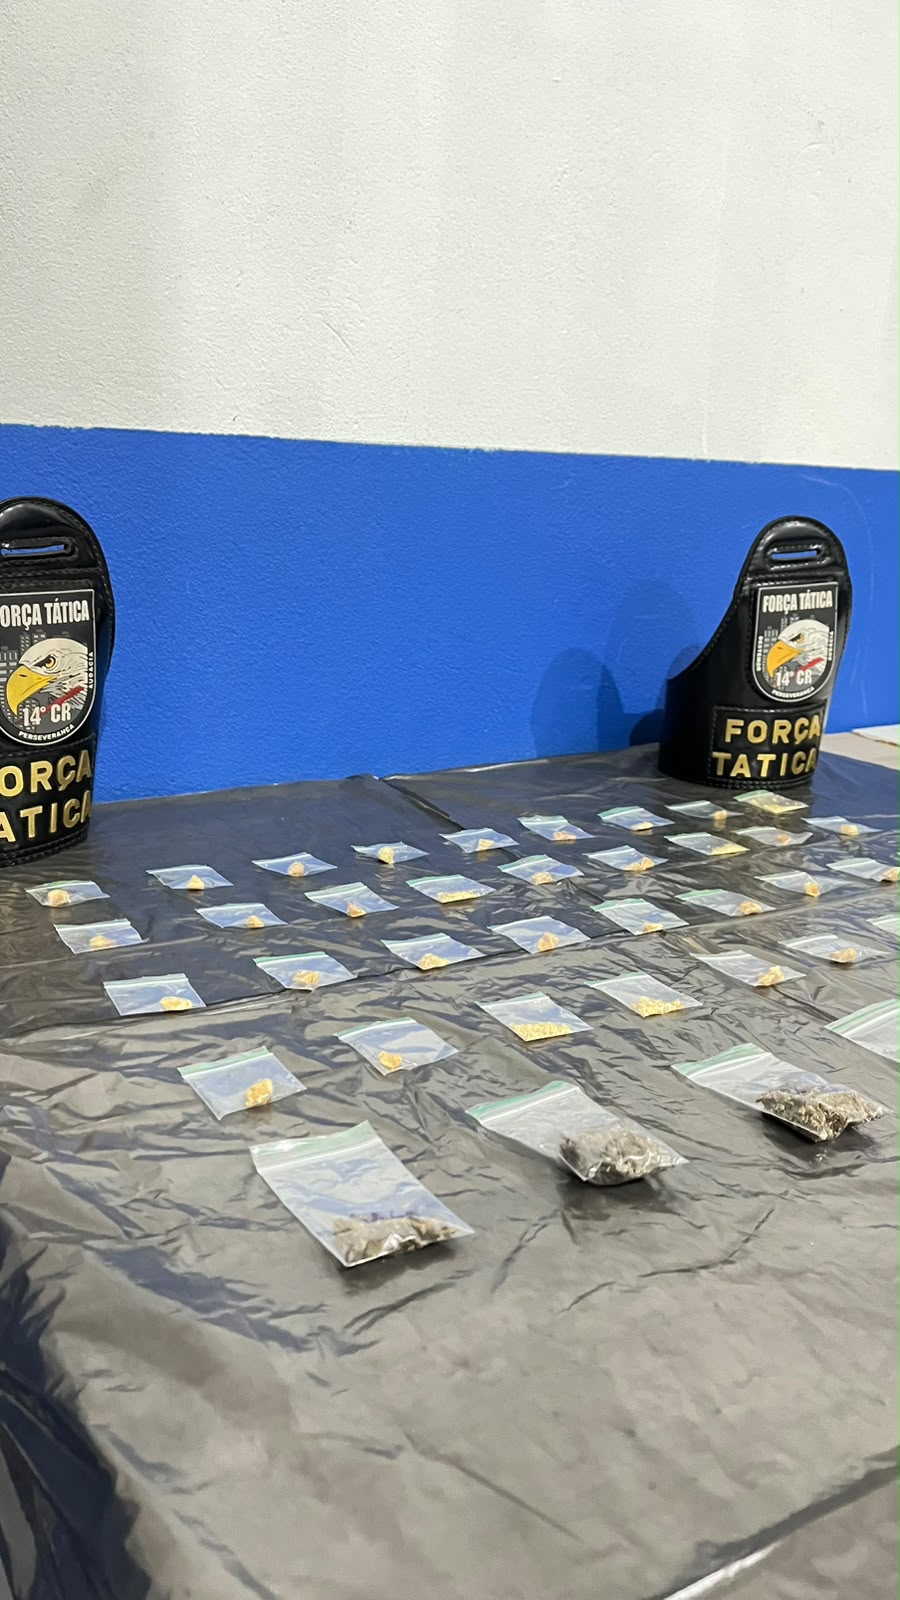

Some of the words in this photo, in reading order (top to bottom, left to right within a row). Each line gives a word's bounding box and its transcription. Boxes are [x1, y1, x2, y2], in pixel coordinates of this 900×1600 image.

[0, 603, 43, 631] ORÇA
[44, 597, 90, 625] TÁTICA
[762, 593, 798, 615] FORÇA
[798, 589, 833, 611] TÁTICA
[796, 669, 813, 685] CR
[50, 702, 71, 723] CR
[724, 714, 821, 745] FORÇA
[0, 749, 93, 798] ORÇA
[711, 747, 817, 778] TATICA
